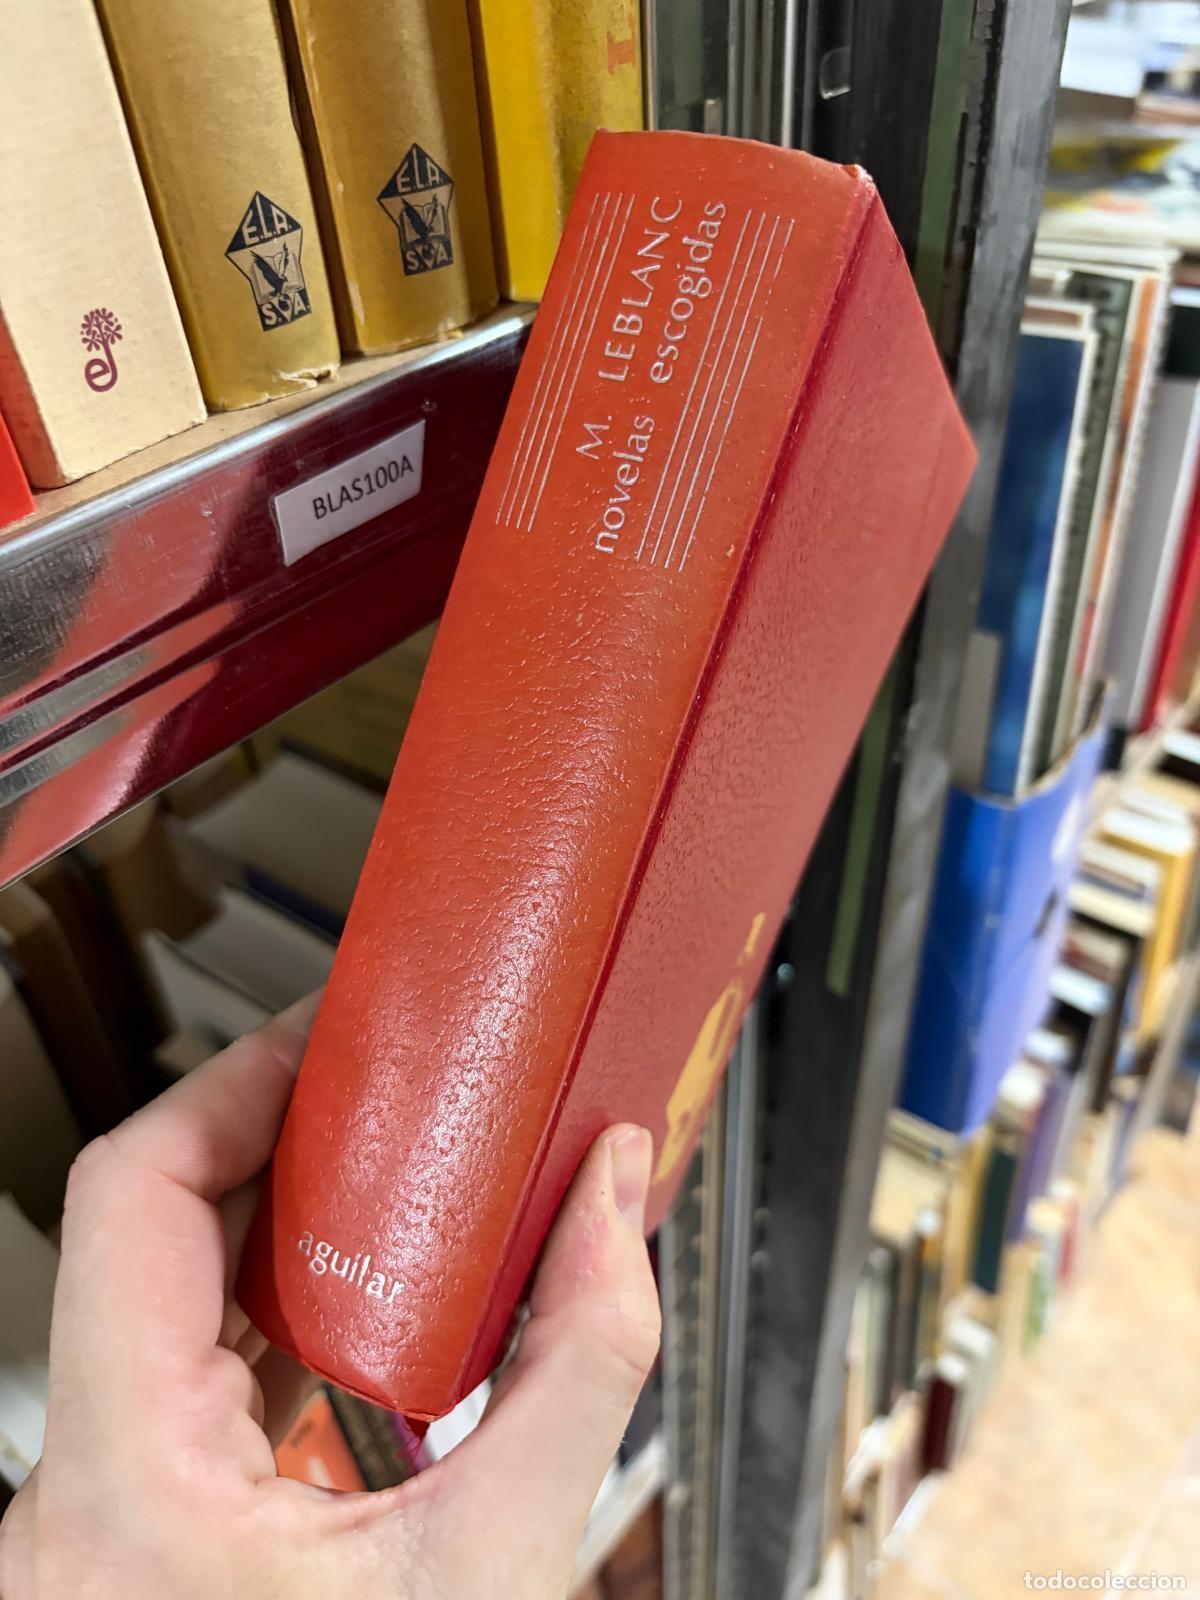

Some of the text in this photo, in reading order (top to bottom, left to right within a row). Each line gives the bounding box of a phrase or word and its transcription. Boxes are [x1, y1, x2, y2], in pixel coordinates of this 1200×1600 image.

[575, 195, 683, 461] M. LEBLANC
[594, 201, 727, 554] novelas escogidas
[312, 453, 414, 521] BLAS100A
[298, 1230, 405, 1304] aguilar
